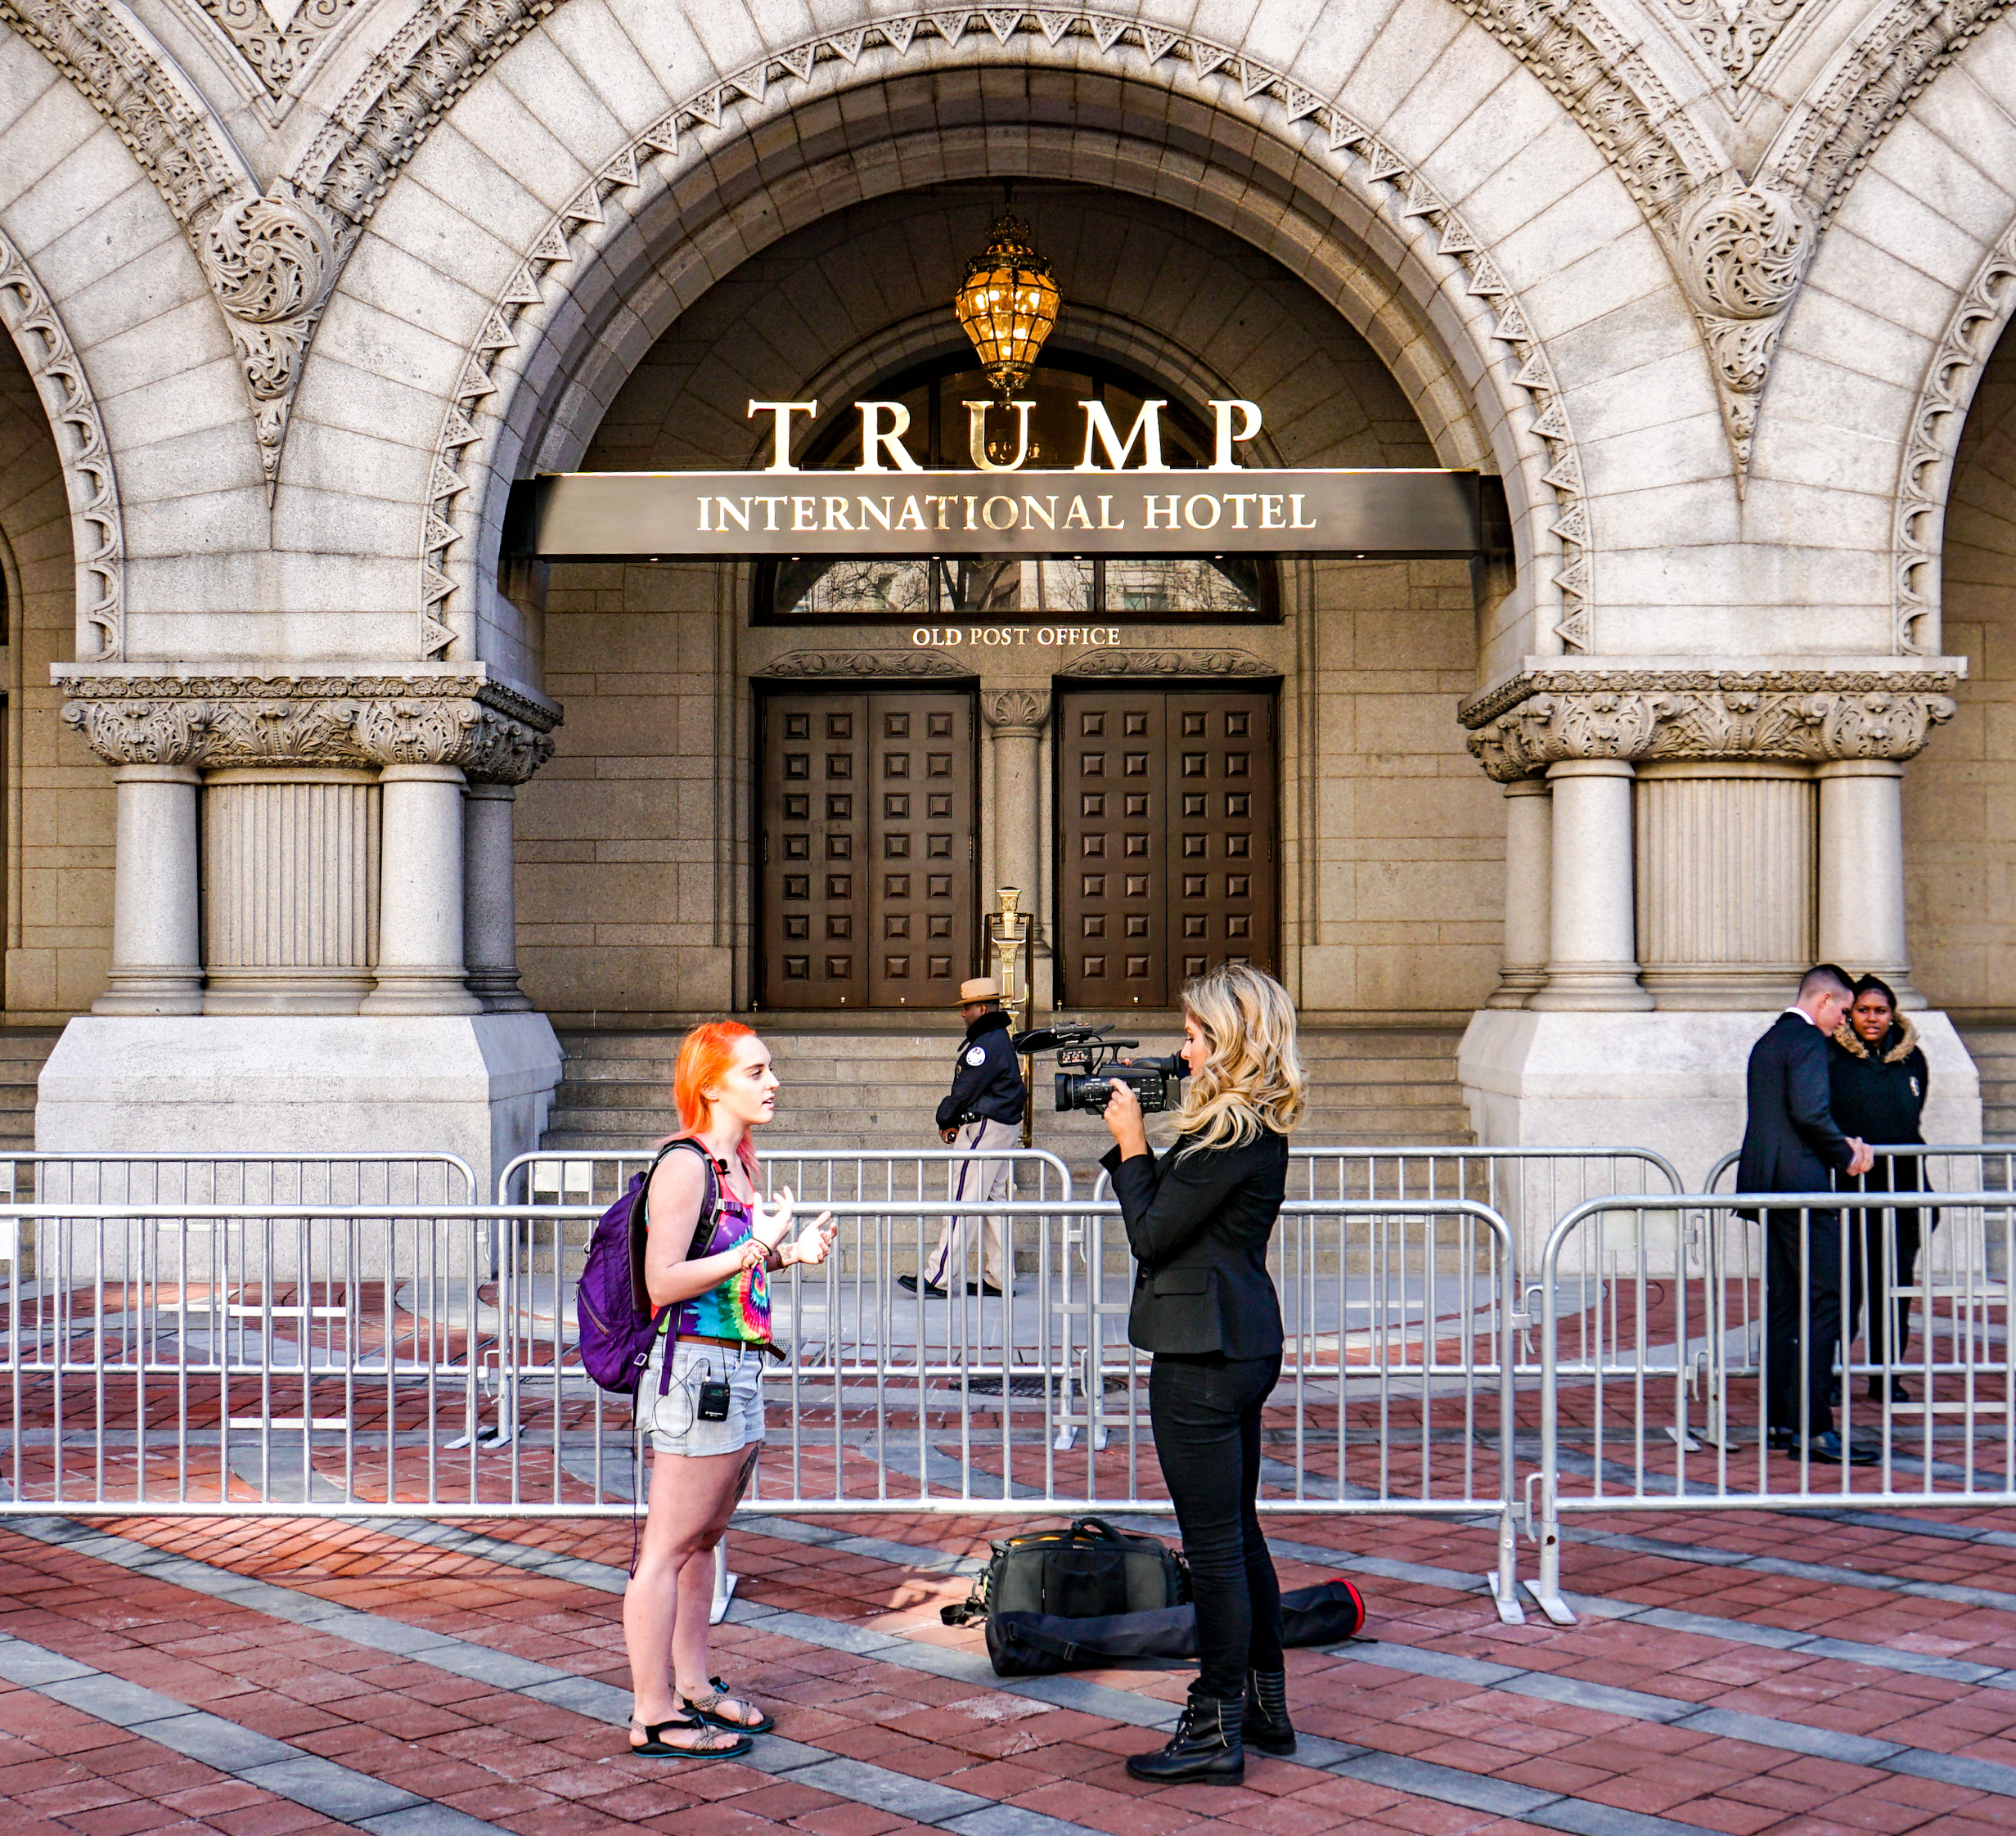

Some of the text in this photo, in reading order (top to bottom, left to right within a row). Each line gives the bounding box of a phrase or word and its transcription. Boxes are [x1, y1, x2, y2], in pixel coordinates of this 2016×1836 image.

[747, 398, 1262, 471] TRUMP
[696, 493, 1318, 532] INTERNATIONAL HOTEL
[912, 628, 962, 646] OLD
[970, 628, 1031, 646] POST
[1037, 627, 1121, 646] OFFICE
